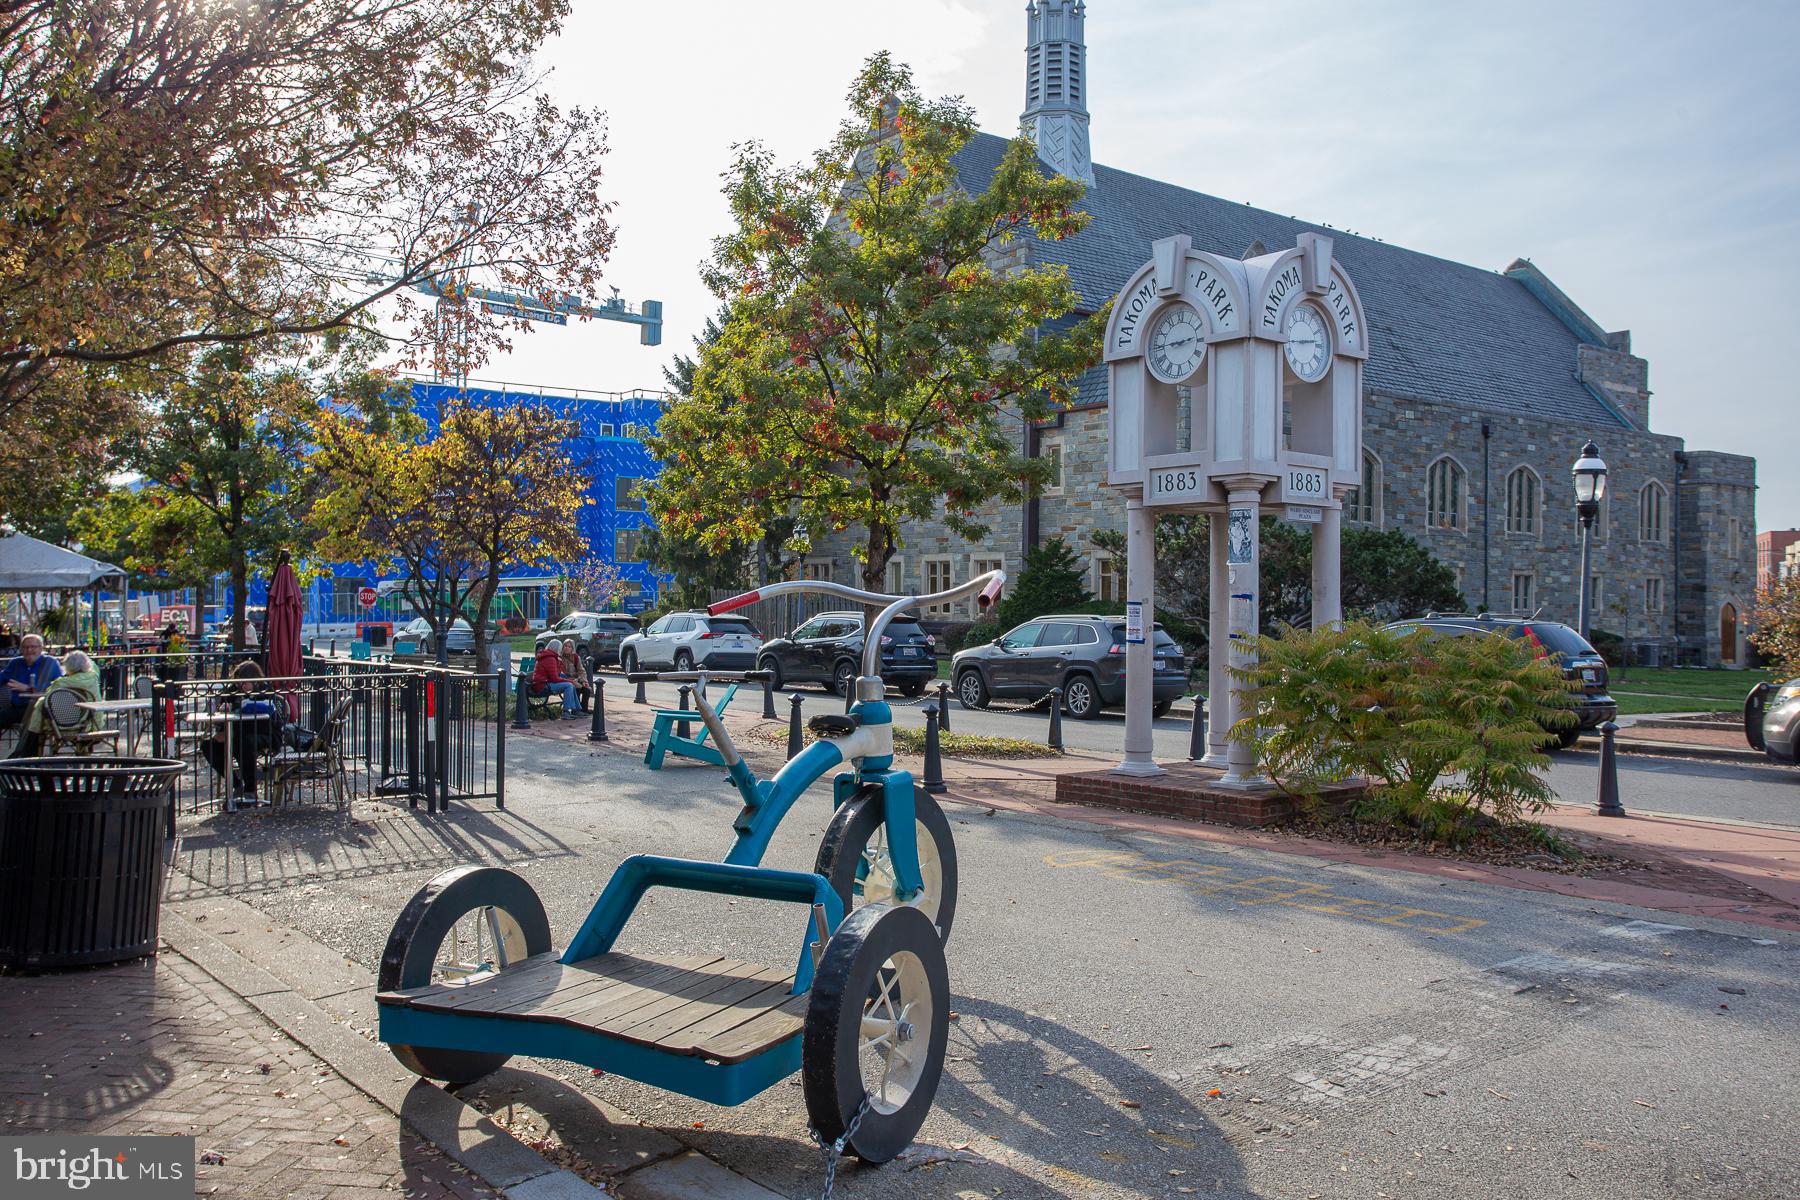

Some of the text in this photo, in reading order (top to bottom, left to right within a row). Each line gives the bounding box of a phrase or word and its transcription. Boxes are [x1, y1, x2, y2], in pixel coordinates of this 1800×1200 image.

[1195, 270, 1233, 322] PARK
[1263, 266, 1355, 336] TAKOMA PARK
[1157, 471, 1197, 492] 1883
[1290, 471, 1321, 493] 1883
[360, 592, 376, 600] STOP
